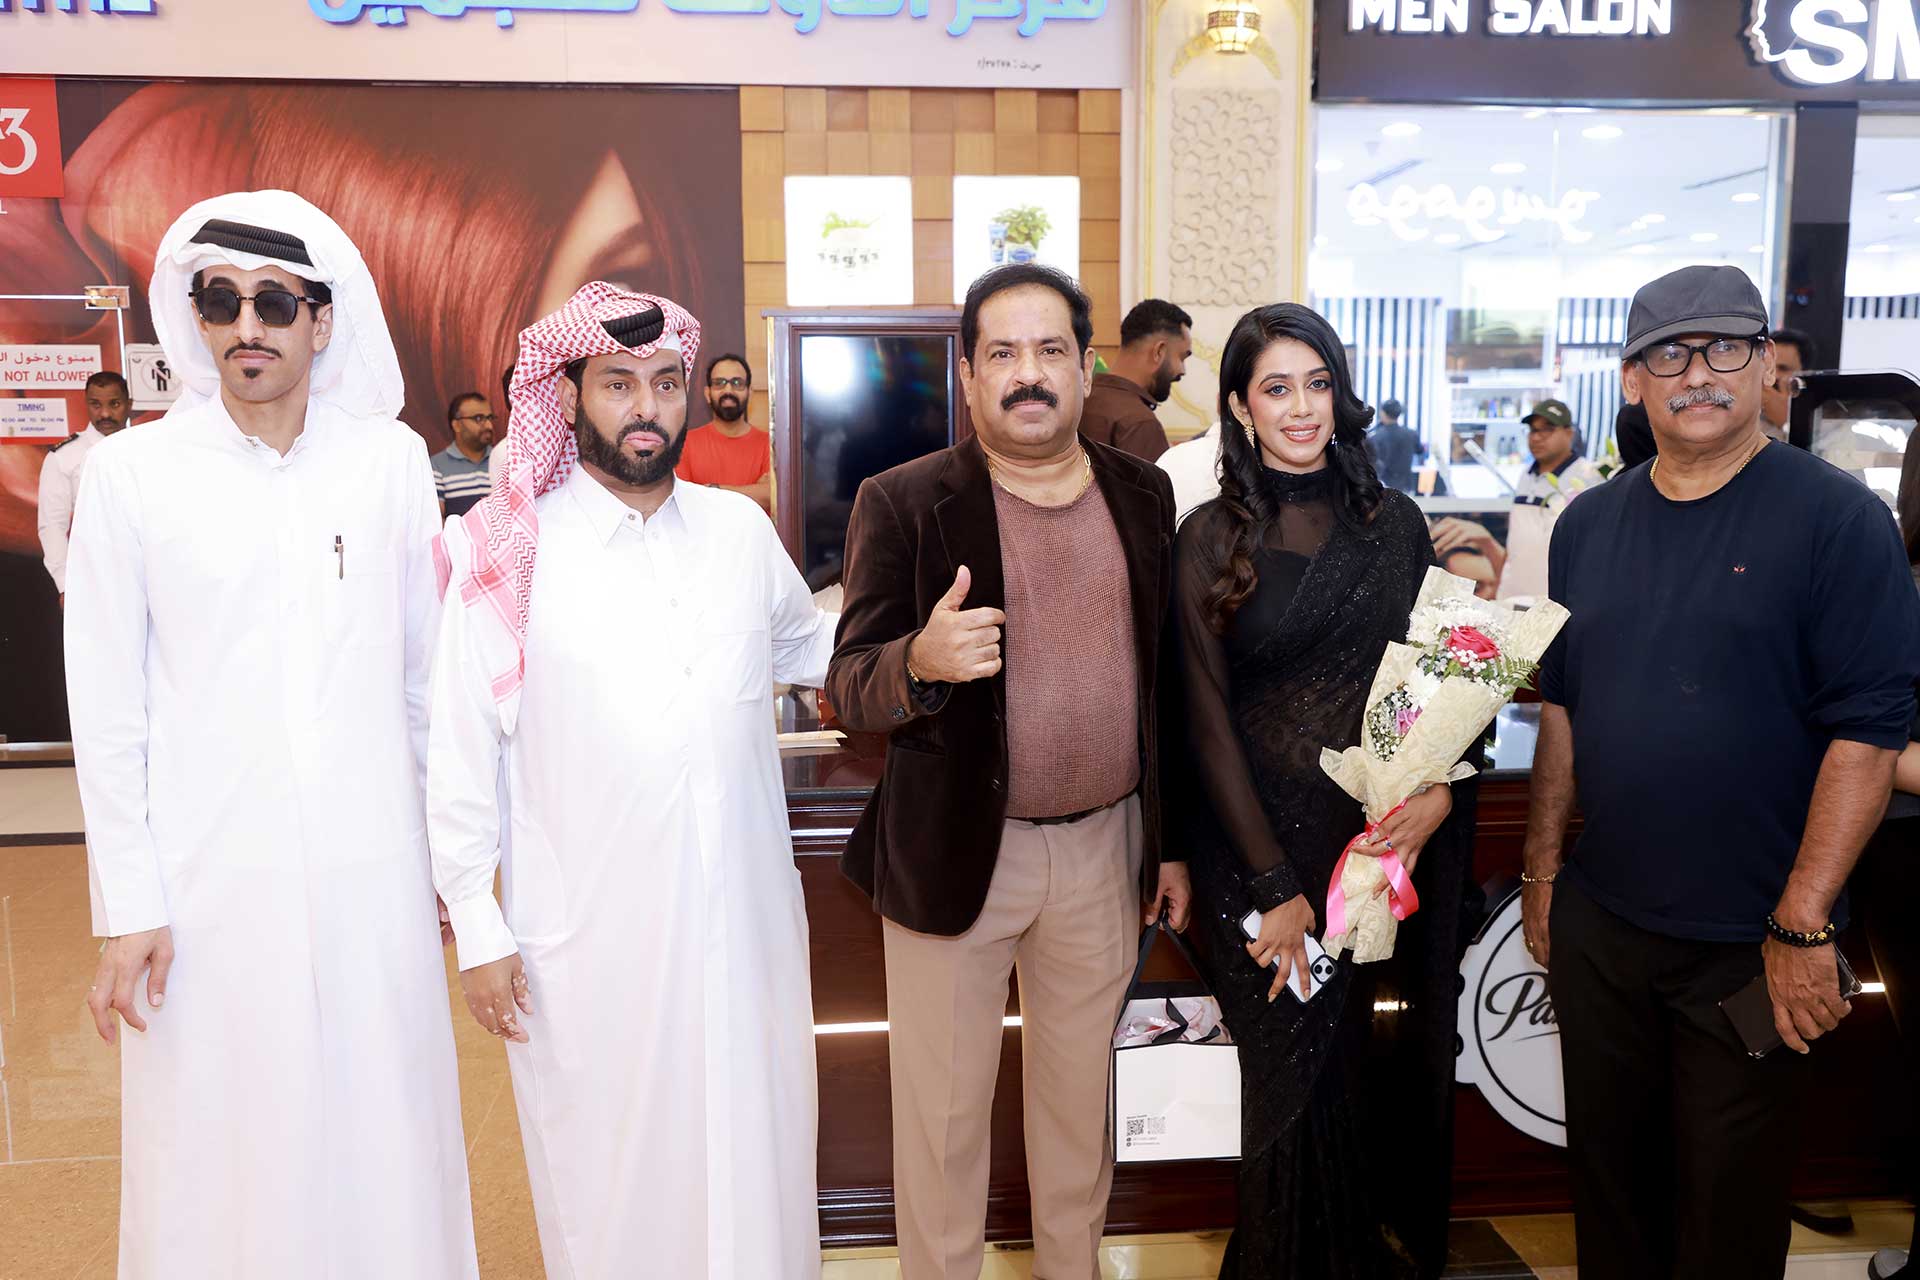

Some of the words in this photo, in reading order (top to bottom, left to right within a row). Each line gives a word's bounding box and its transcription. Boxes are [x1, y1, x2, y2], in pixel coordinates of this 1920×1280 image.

[1348, 0, 1469, 33] MEN
[1488, 0, 1672, 35] SALON
[0, 107, 38, 175] 3
[15, 352, 50, 365] دخول
[56, 354, 94, 365] ممنوع
[4, 370, 30, 382] NOT
[17, 403, 46, 412] TIMING
